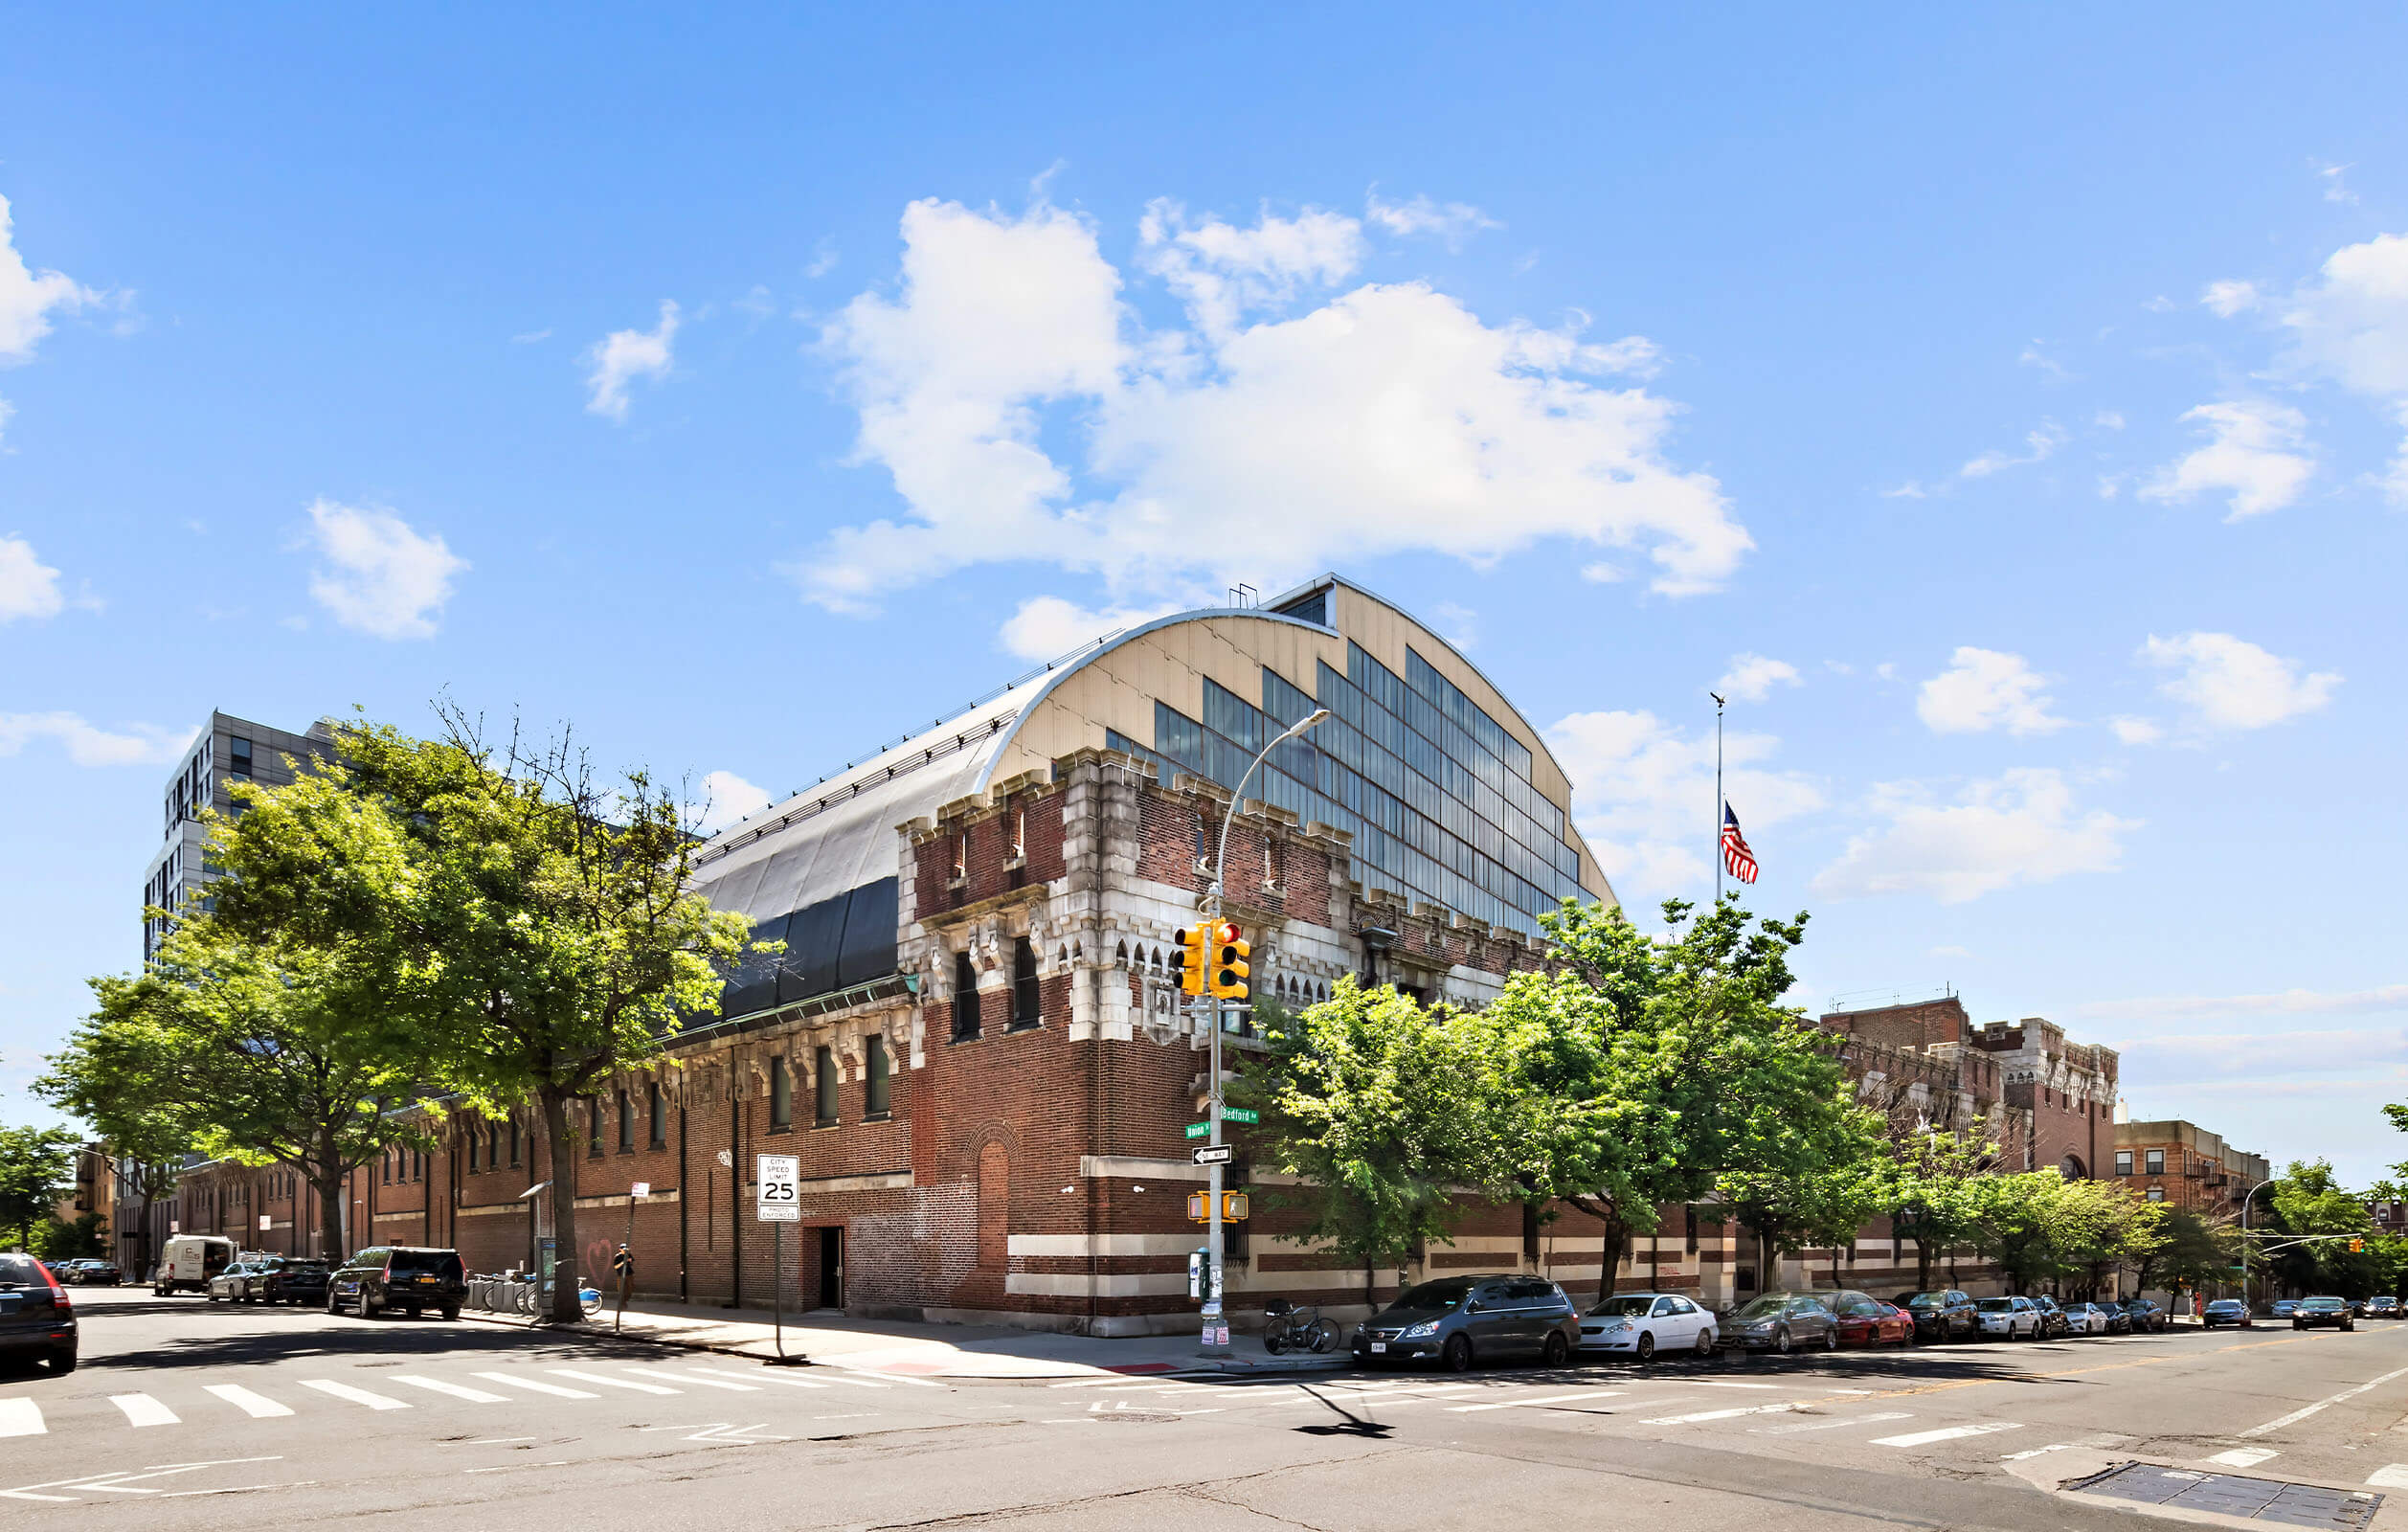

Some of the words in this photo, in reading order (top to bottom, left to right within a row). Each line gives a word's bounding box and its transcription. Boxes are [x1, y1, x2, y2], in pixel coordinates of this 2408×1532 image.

[1222, 1108, 1249, 1121] Bedford
[1187, 1126, 1204, 1137] Union
[765, 1183, 794, 1200] 25
